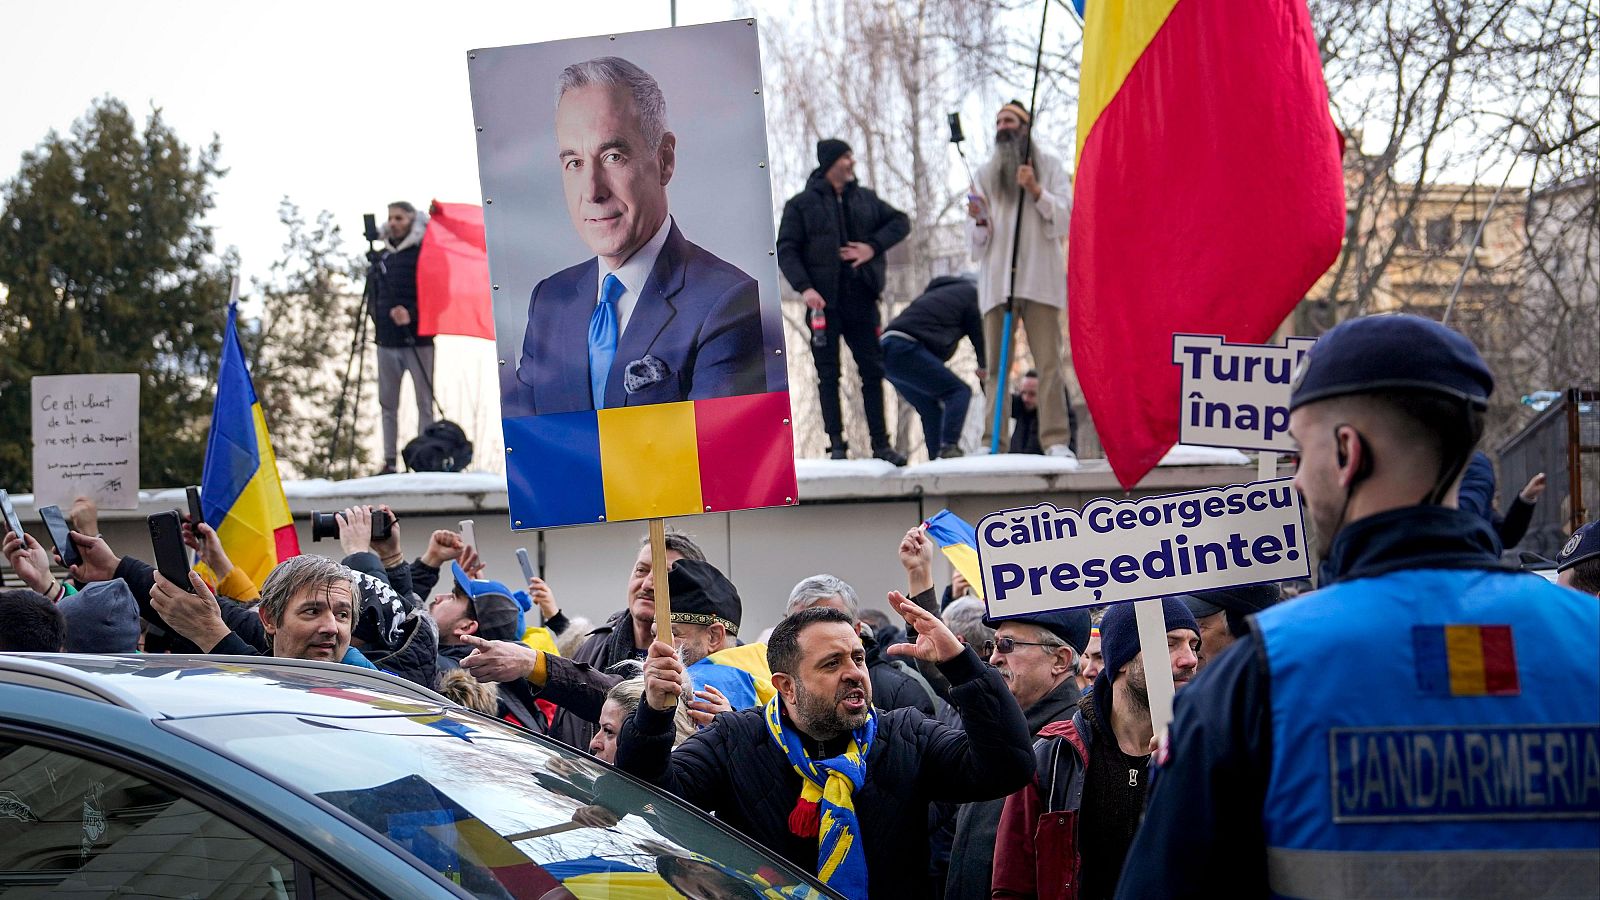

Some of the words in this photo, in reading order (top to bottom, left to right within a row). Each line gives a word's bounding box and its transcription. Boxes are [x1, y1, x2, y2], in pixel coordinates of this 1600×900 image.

[1184, 346, 1306, 385] Turu
[41, 394, 58, 411] Ce
[48, 416, 60, 428] de
[66, 415, 76, 425] la
[1188, 391, 1291, 441] înap
[984, 511, 1078, 548] Călin
[1089, 486, 1293, 534] Georgescu
[991, 523, 1300, 601] Președinte!
[1341, 732, 1599, 809] JANDARMERIA
